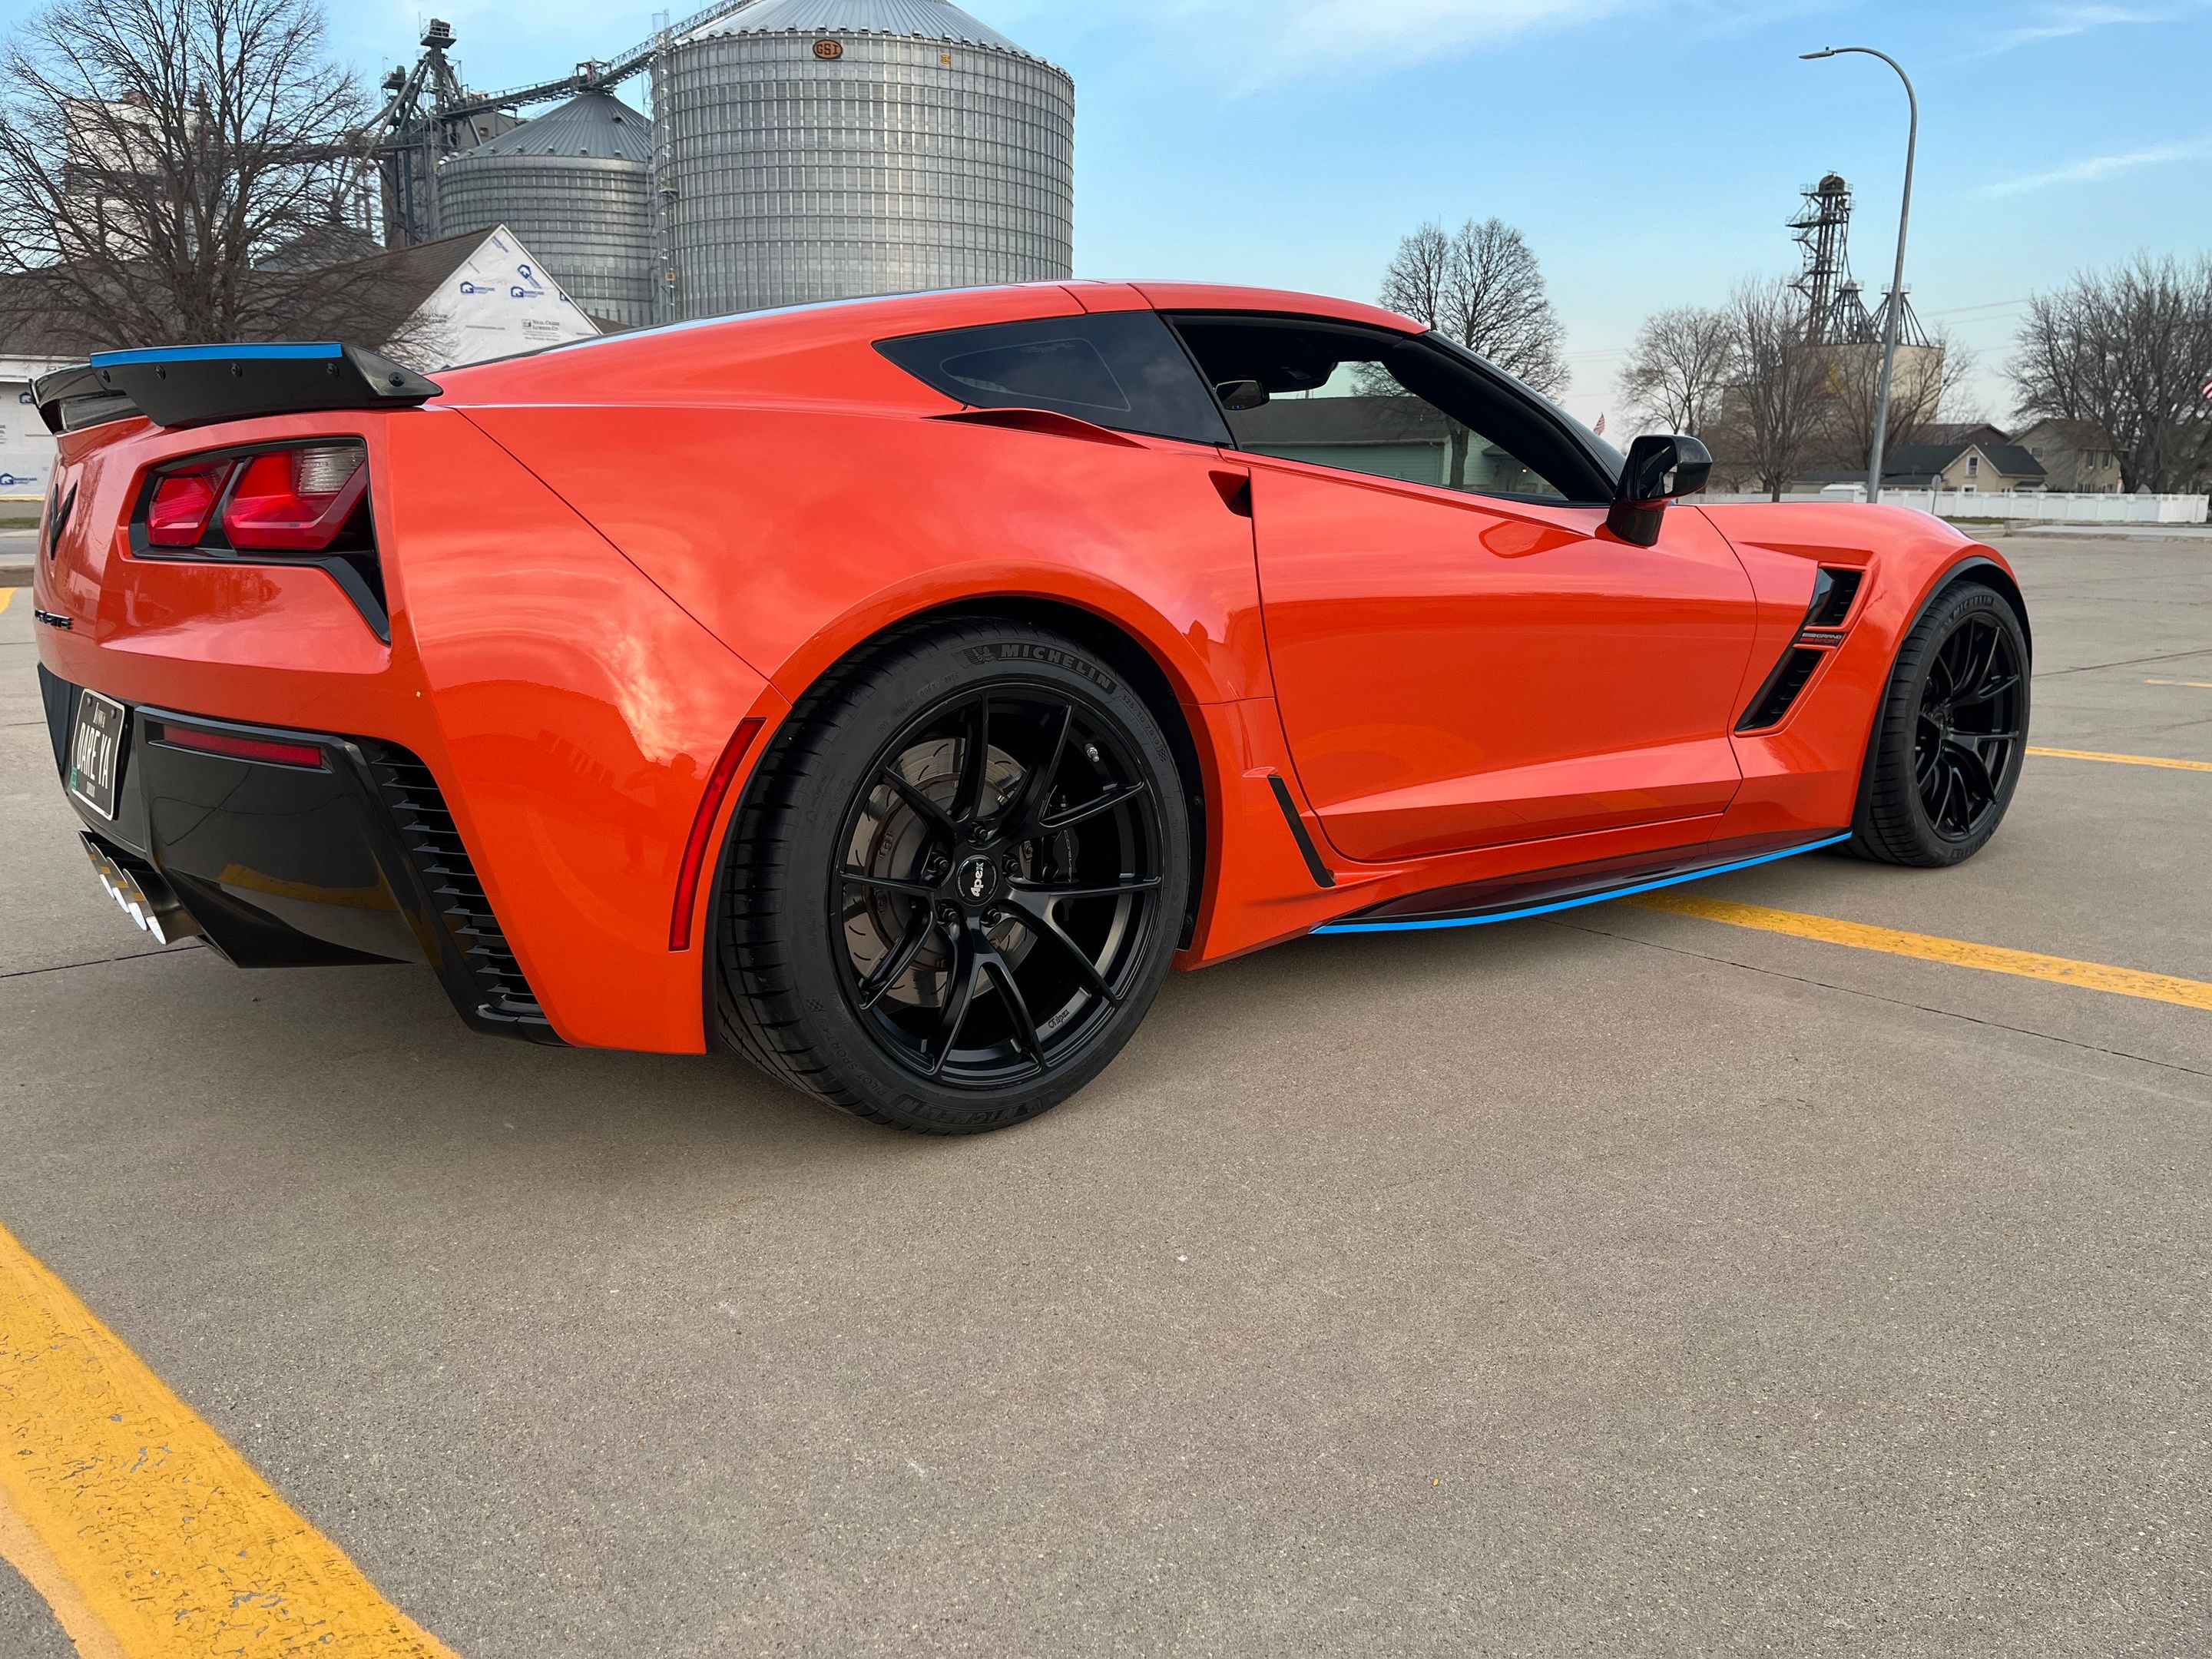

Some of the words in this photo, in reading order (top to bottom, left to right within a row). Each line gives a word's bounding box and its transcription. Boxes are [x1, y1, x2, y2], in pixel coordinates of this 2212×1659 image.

[816, 44, 839, 55] GSI
[1001, 644, 1111, 689] MICHELIN
[77, 722, 101, 780] DARE
[98, 733, 111, 790] YA
[970, 862, 984, 897] Apex
[896, 1098, 1021, 1124] MICHELIN
